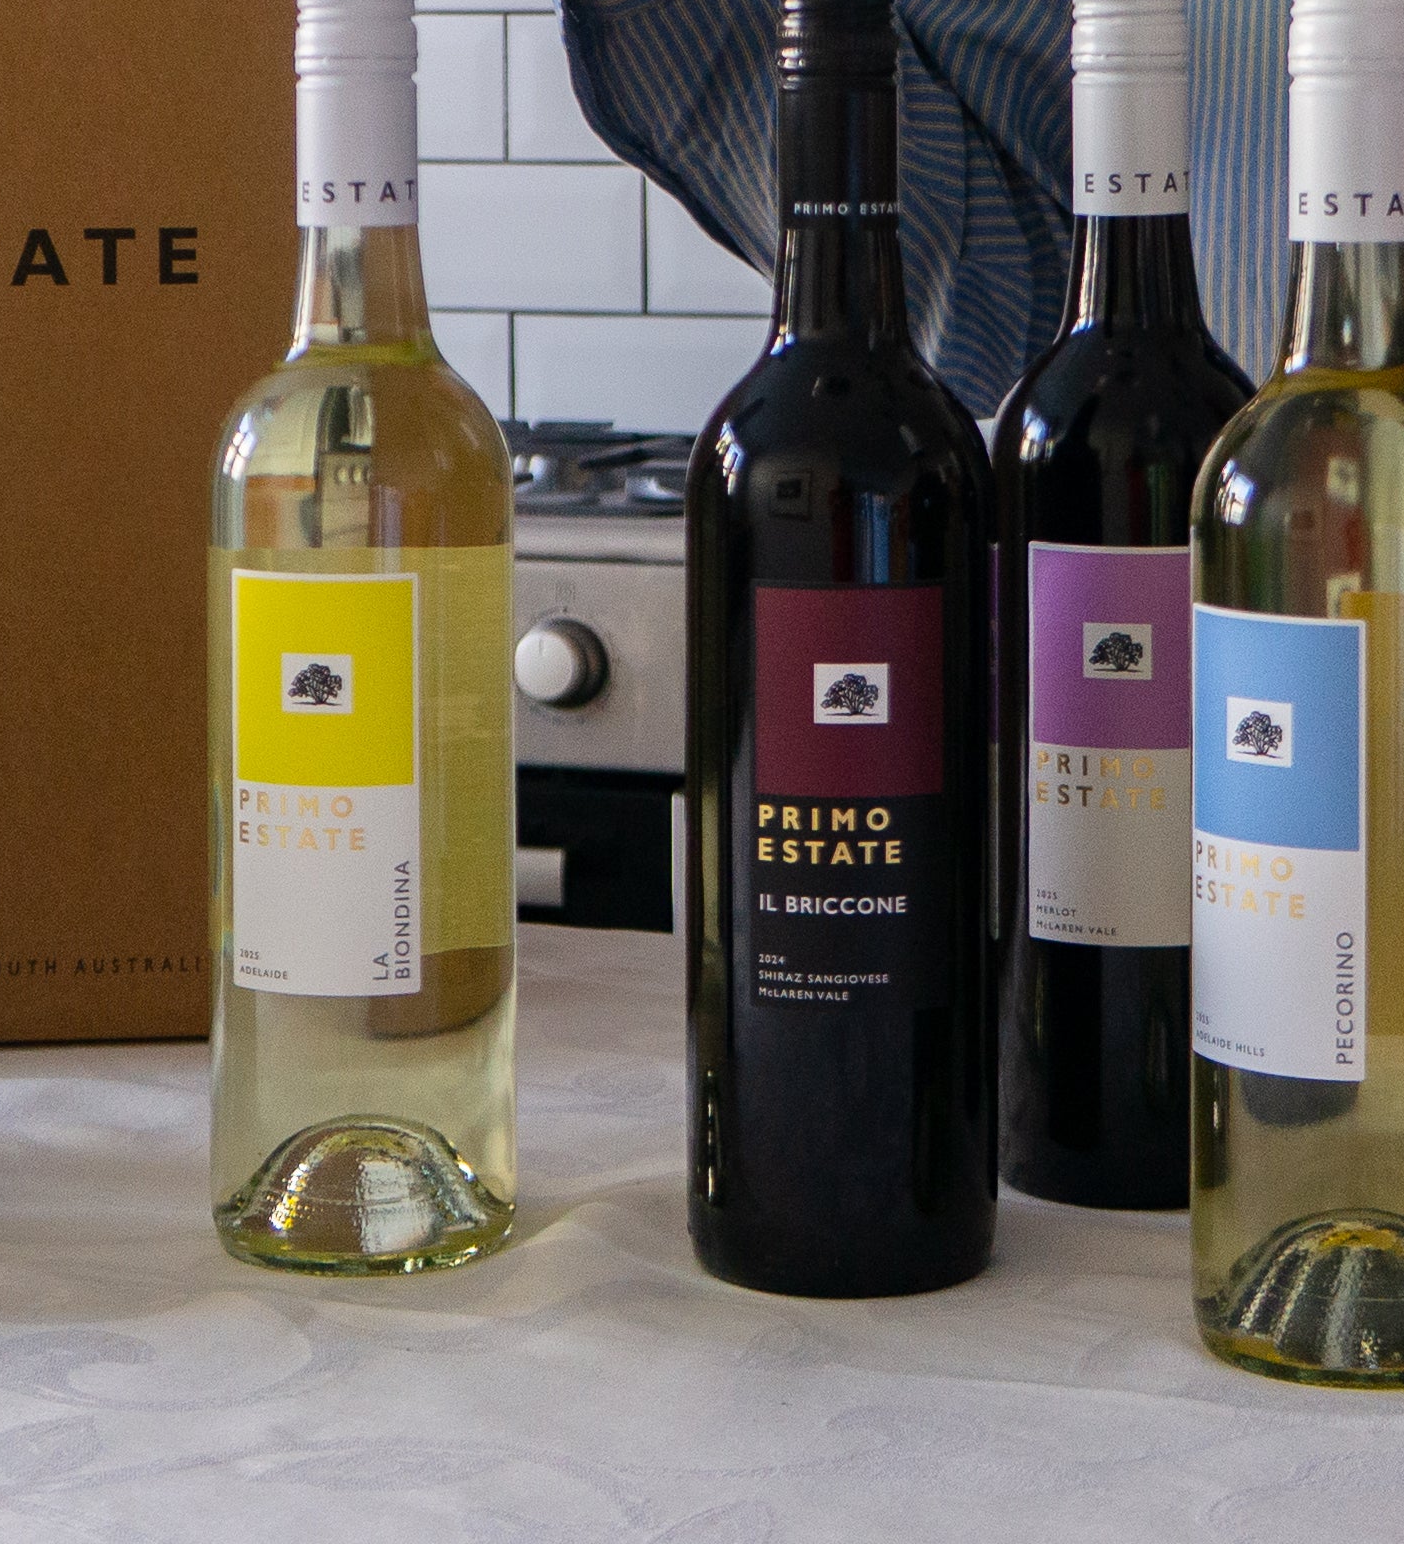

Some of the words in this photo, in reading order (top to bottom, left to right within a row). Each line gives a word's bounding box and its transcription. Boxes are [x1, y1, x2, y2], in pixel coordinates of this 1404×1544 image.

[301, 179, 416, 204] ESTAT
[1084, 170, 1190, 194] ESTAT
[793, 202, 848, 215] PRIMO
[1035, 749, 1155, 780] PRIMO
[238, 788, 354, 819] PRIMO
[1035, 780, 1167, 810] ESTATE
[758, 804, 890, 832] PRIMO
[238, 820, 366, 851] ESTATE
[757, 837, 903, 865] ESTATE
[1195, 839, 1294, 882] PRIMO
[759, 893, 779, 912] IL
[784, 895, 909, 915] BRICCONE
[1195, 874, 1306, 920] ESTATE
[394, 859, 411, 980] BIONDINA
[1035, 904, 1077, 918] MERLOT
[1035, 919, 1084, 935] McLAREN
[1088, 925, 1118, 937] VALE
[73, 955, 203, 976] AUSTRALI
[372, 951, 389, 982] LA
[758, 953, 786, 965] 2024
[238, 965, 289, 981] ADELAIDE
[758, 969, 803, 983] SHIRAZ
[807, 973, 890, 985] SANGIOVESE
[758, 987, 814, 1001] McLAREN
[817, 990, 850, 1002] VALE
[1335, 931, 1355, 1065] PECORINO
[1235, 1042, 1265, 1058] HILLS
